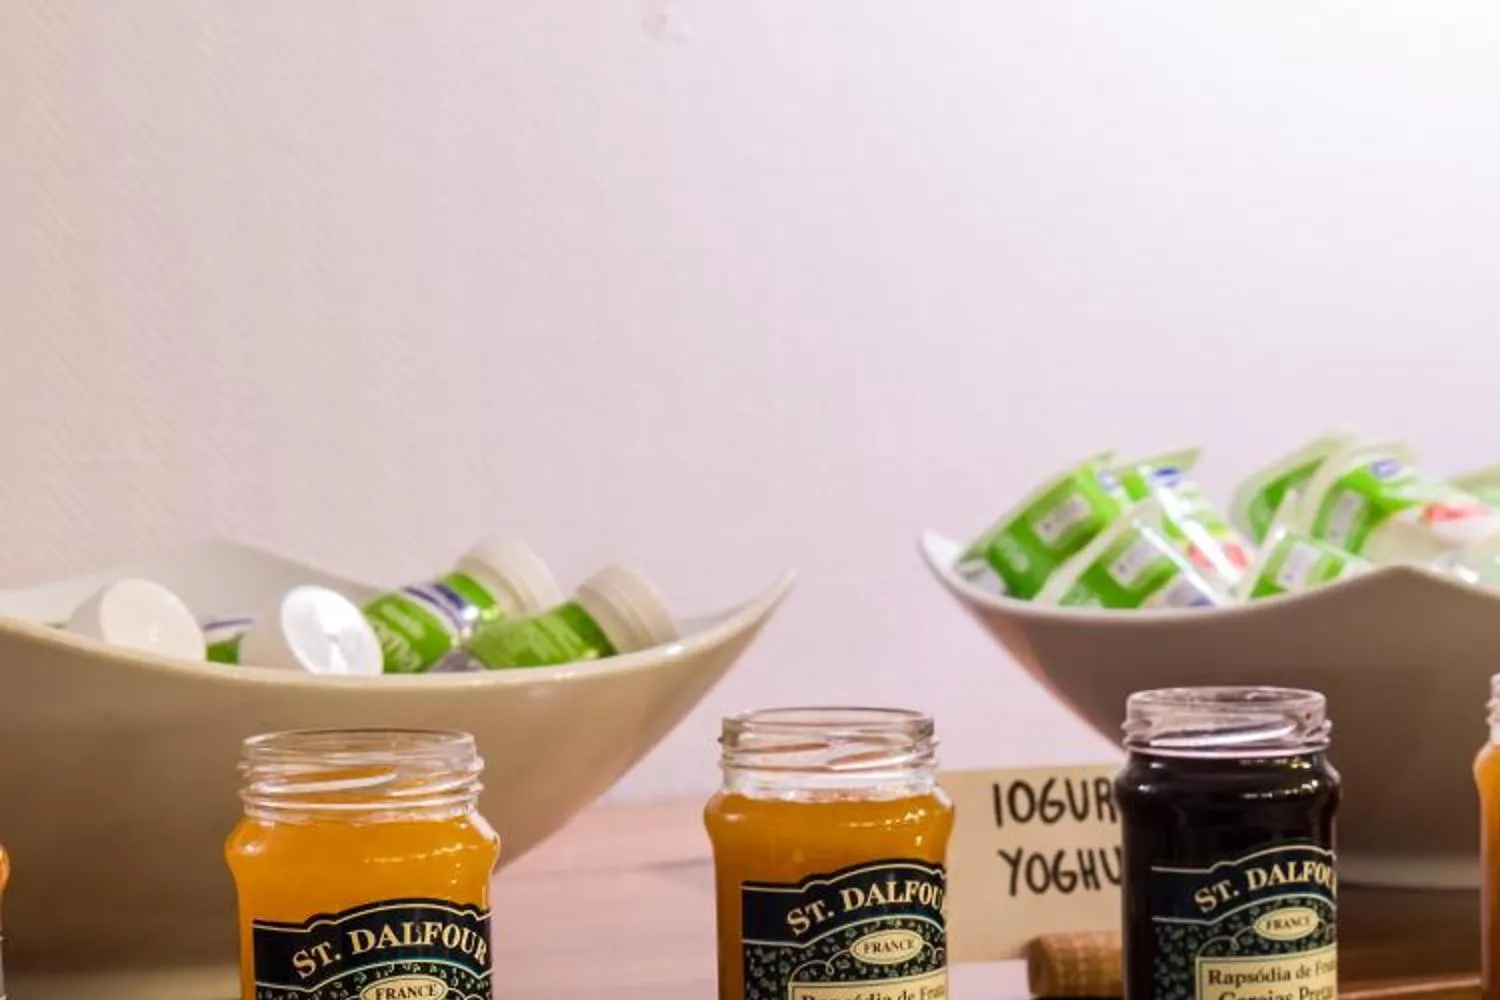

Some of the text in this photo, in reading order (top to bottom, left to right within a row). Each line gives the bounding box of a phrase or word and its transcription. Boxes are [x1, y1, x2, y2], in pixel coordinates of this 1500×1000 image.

[992, 777, 1118, 828] IOGUR
[997, 845, 1122, 897] YOGHU
[1194, 860, 1336, 913] ST. DALFOU
[787, 899, 835, 935] ST.
[293, 921, 488, 979] ST. DALFOUR
[863, 938, 916, 955] FRANCE
[1208, 966, 1291, 988] Rapsódia
